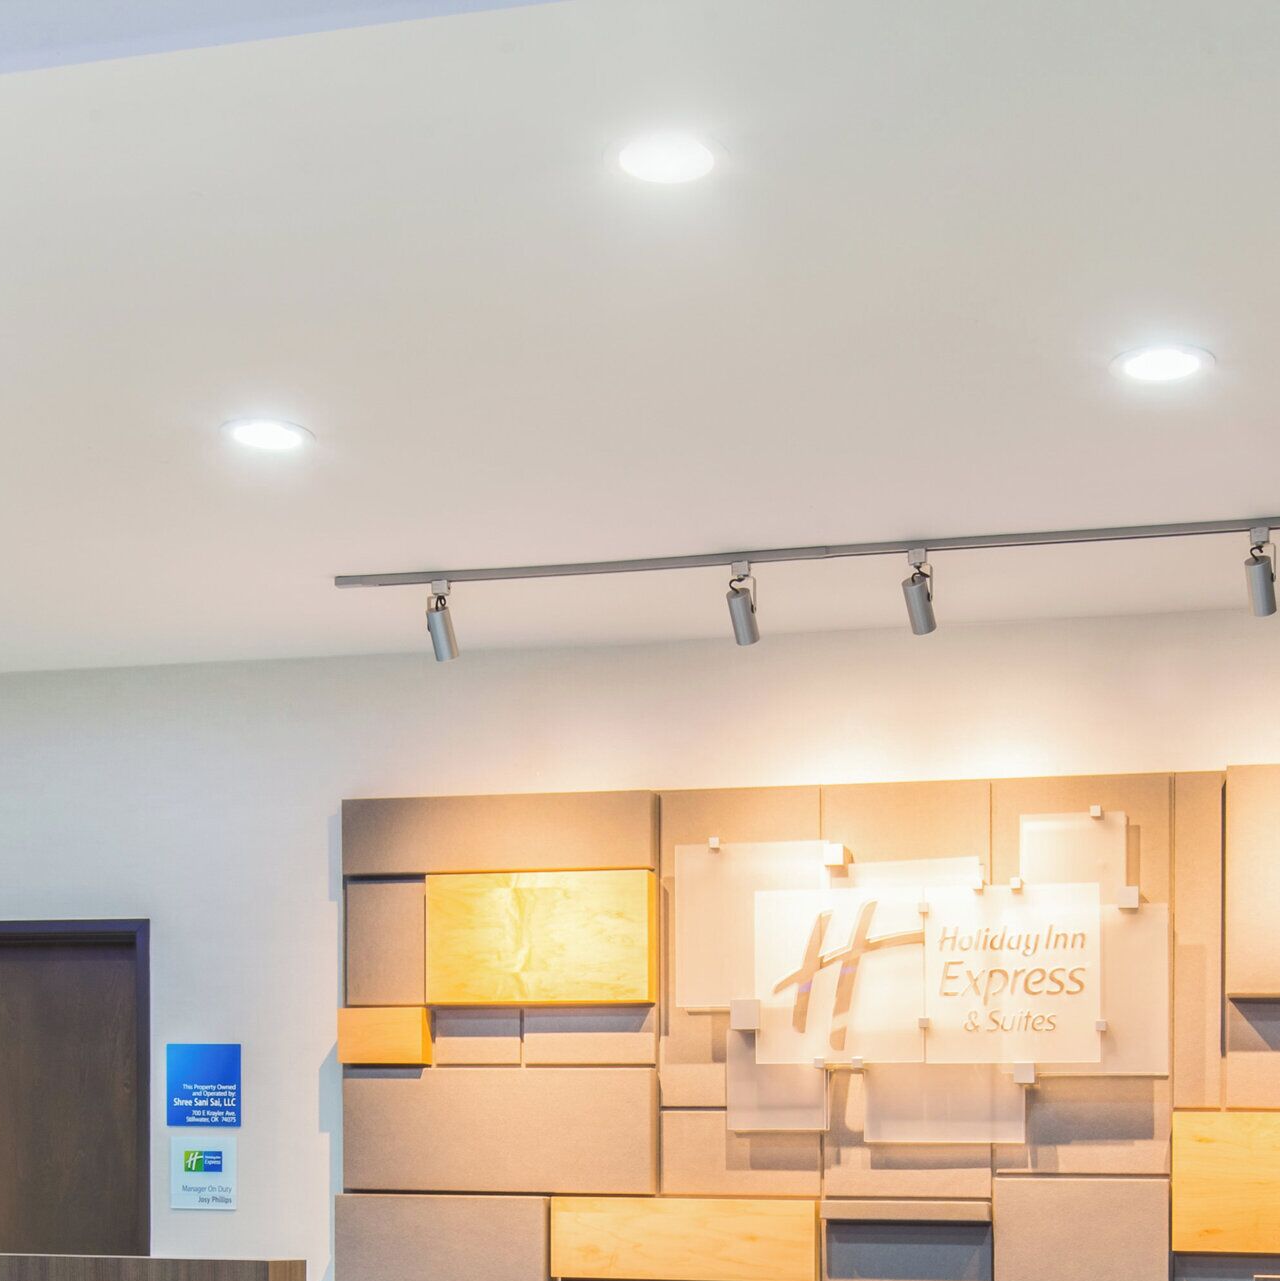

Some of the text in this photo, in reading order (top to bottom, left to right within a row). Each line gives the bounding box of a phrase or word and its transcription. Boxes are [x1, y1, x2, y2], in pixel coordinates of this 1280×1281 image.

[938, 923, 1087, 957] Holiday Inn
[938, 960, 1087, 1007] Express
[963, 1008, 1057, 1033] & Suites
[173, 1098, 193, 1107] Shree
[223, 1098, 236, 1107] LLC
[182, 1184, 232, 1194] Manager On Duty
